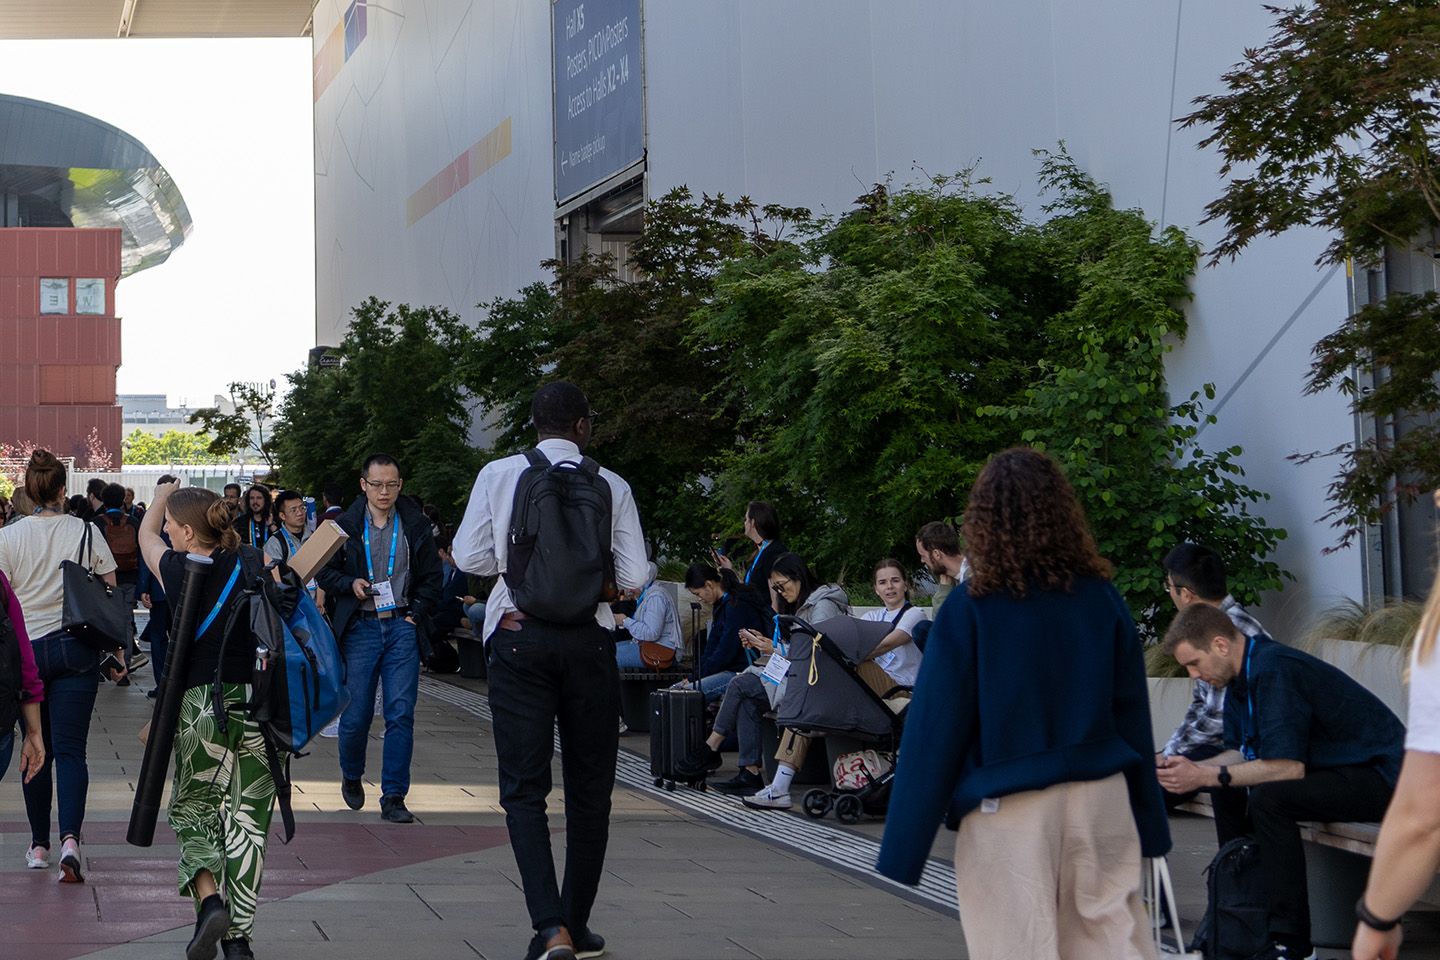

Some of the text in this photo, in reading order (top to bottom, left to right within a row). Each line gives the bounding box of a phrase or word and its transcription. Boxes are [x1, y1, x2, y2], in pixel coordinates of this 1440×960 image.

[565, 3, 585, 41] Hall X5
[567, 90, 586, 121] Access
[593, 71, 607, 105] Halls
[607, 63, 616, 95] X2
[620, 53, 629, 86] X4
